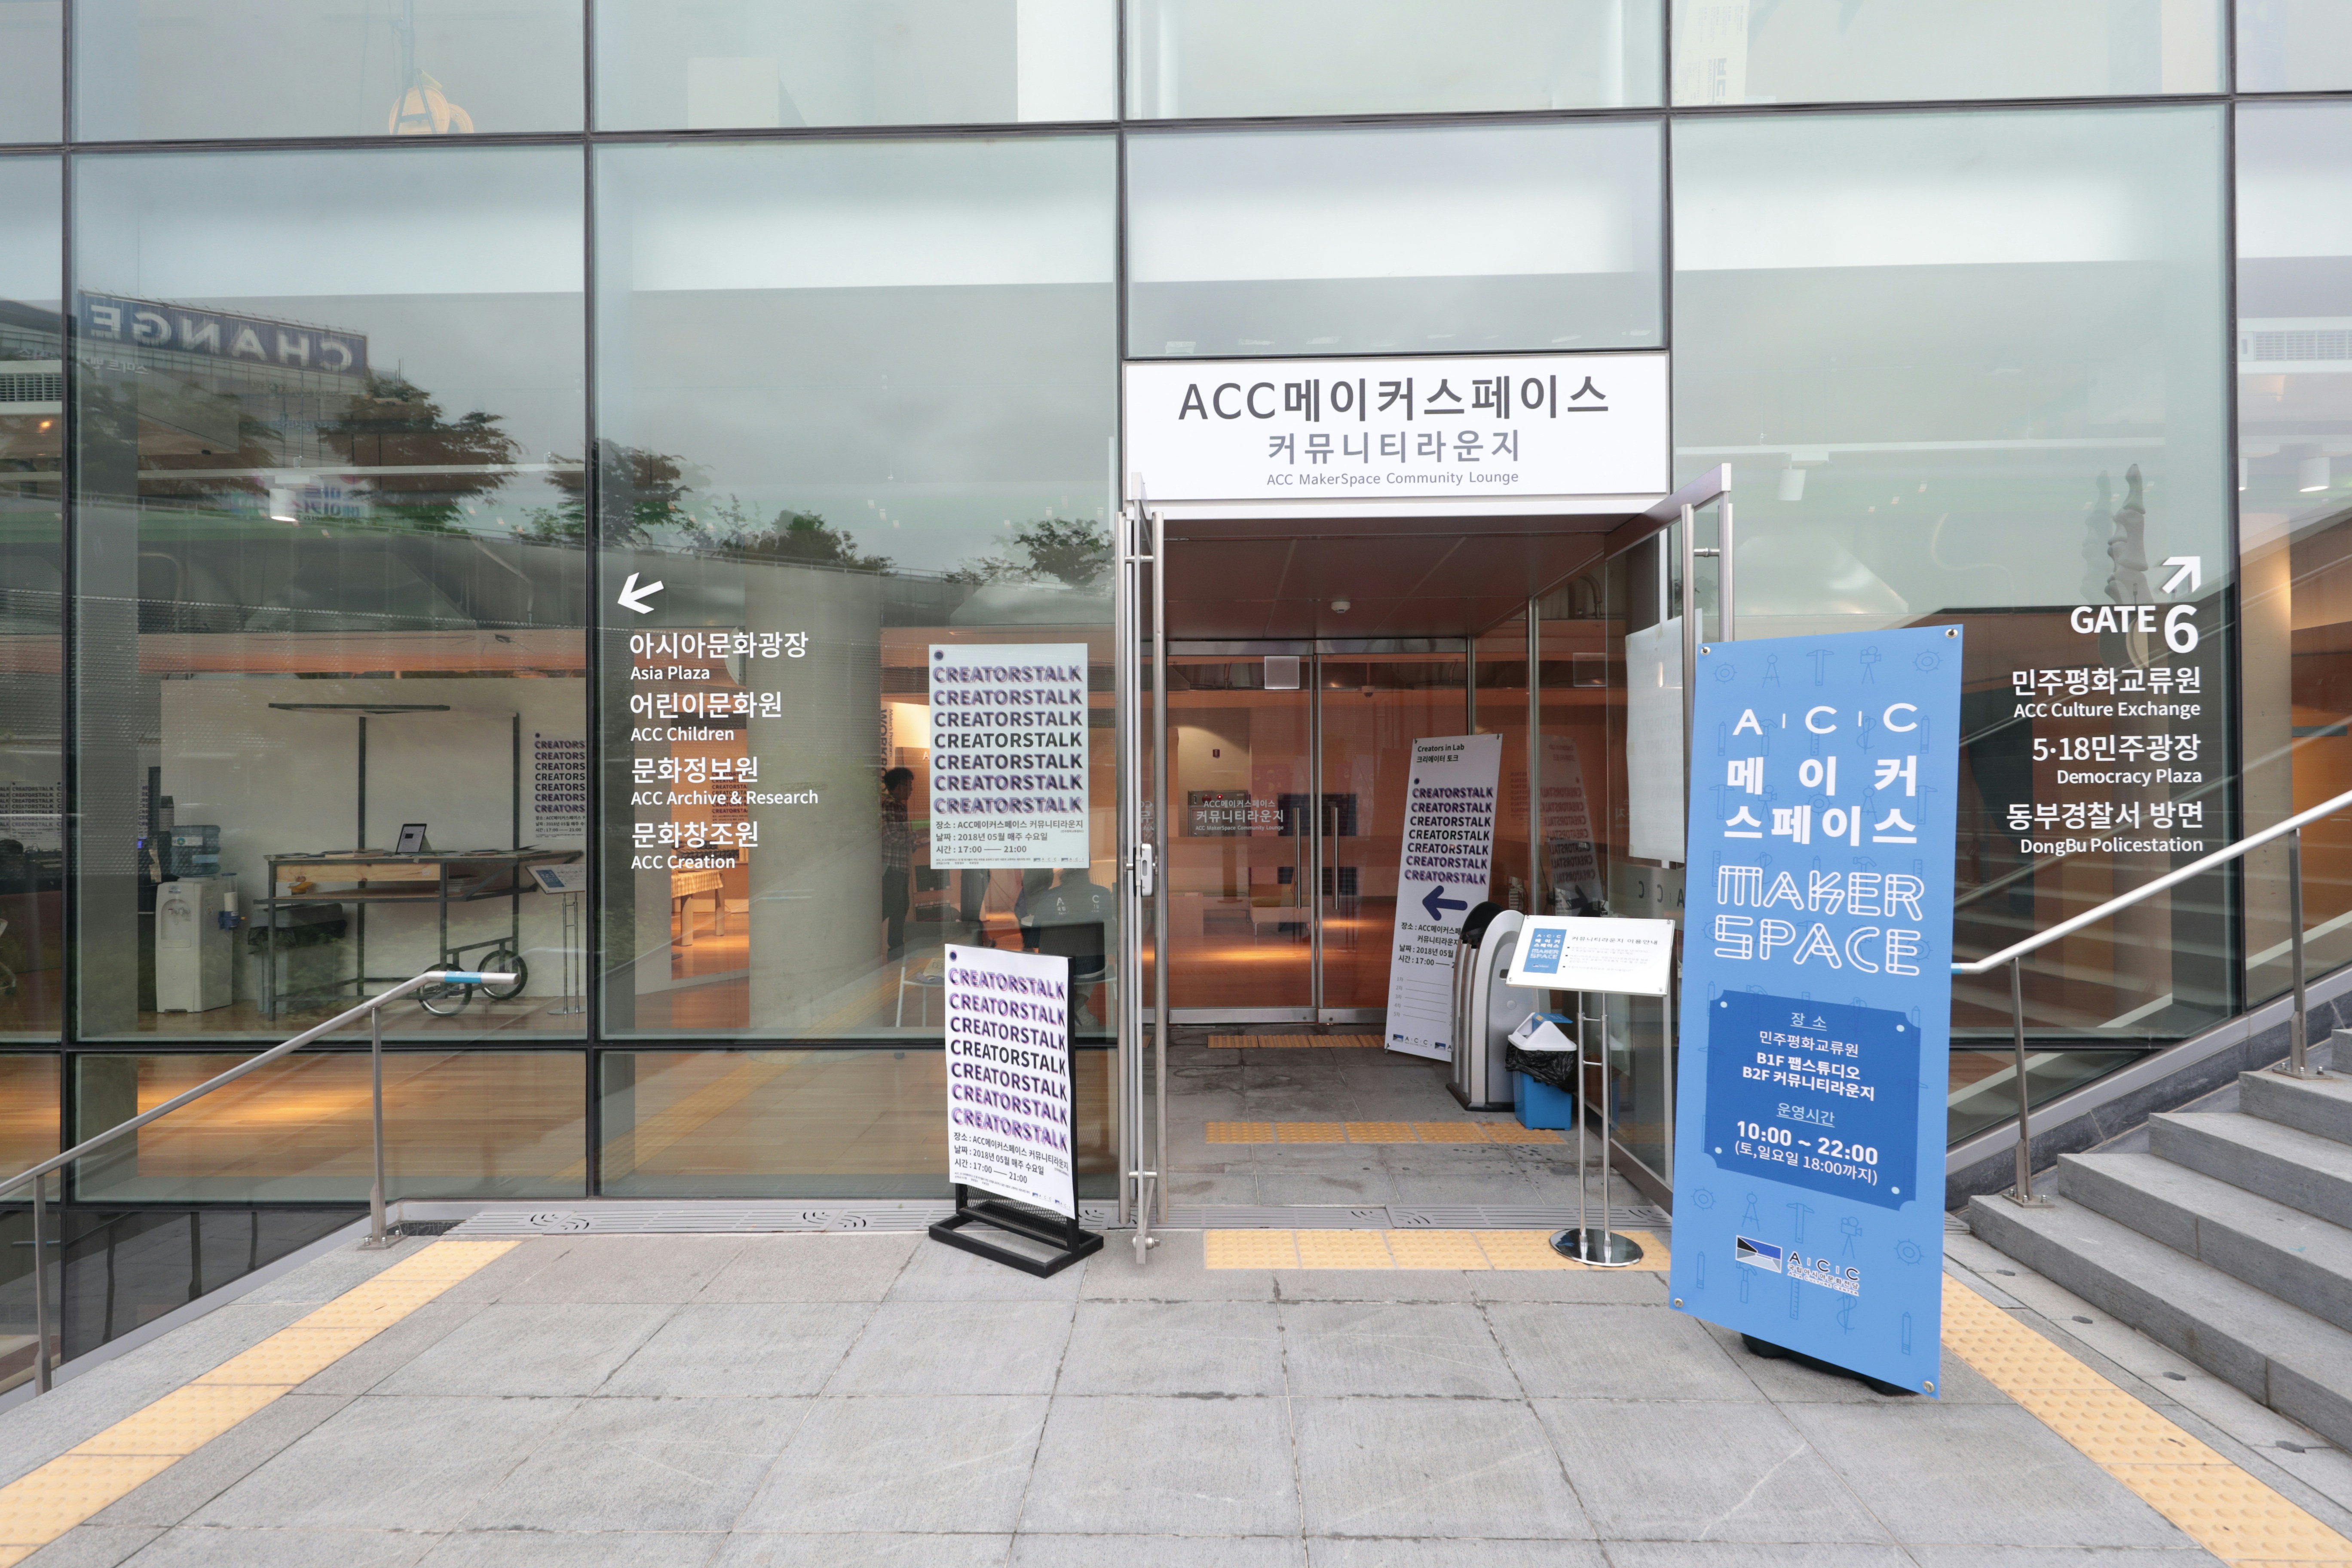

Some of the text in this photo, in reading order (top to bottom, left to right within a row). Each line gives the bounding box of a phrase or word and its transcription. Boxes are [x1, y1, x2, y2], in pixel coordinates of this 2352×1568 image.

[1179, 375, 1608, 422] ACC메이커스페이스
[1268, 430, 1519, 464] 커뮤니티라운지
[1267, 471, 1519, 487] ACC MakerSpace Community Lounge
[2070, 604, 2198, 653] GATE 6
[630, 631, 809, 659] 아시아문화광장
[631, 666, 710, 680] Asia Plaza
[933, 665, 1084, 683] CREATORSTALK
[2012, 667, 2200, 696] 민주평화교류원
[630, 692, 781, 719] 어린이문화원
[933, 688, 1084, 706] CREATORSTALK
[934, 710, 1083, 727] CREATORSTALK
[2014, 701, 2200, 720] ACC Culture Exchange
[631, 726, 734, 741] ACC Children
[934, 732, 1083, 748] CREATORSTALK
[535, 740, 585, 749] CREATORS
[2032, 734, 2201, 762] 5·18민주광장
[535, 752, 585, 760] CREATORS
[934, 753, 1083, 769] CREATORSTALK
[1417, 755, 1445, 763] 크리에이터
[632, 756, 758, 783] 문화정보원
[2057, 769, 2202, 787] Democracy Plaza
[535, 783, 585, 791] CREATORS
[934, 774, 1084, 791] CREATORSTALK
[535, 793, 585, 802] CREATORS
[631, 790, 818, 805] ACC Archive & Research
[1412, 787, 1493, 799] CREATORSTALK
[535, 804, 585, 813] CREATORS
[933, 796, 1084, 814] CREATORSTALK
[1204, 799, 1275, 808] ACC메이커스페이스
[1411, 802, 1492, 813] CREATORSTALK
[958, 820, 1027, 829] ACC메이커스페이스
[1029, 820, 1083, 829] 커뮤니티라운지
[1197, 810, 1283, 823] 커뮤니티라운지
[1410, 816, 1491, 827] CREATORSTALK
[2006, 801, 2203, 830] 동부경찰서 방면
[632, 821, 758, 848] 문화창조원
[1724, 805, 1917, 846] 스페이스
[936, 832, 1048, 842] 날짜 2018년 05월 매주 수요일
[1409, 830, 1490, 841] CREATORSTALK
[936, 845, 1027, 854] 시간 17:00 21:00
[1407, 843, 1488, 855] CREATORSTALK
[2021, 837, 2203, 856] DongBu Policestation
[631, 854, 735, 869] ACC Creation
[1406, 855, 1488, 869] CREATORSTALK
[1405, 869, 1486, 885] CREATORSTALK
[1717, 865, 1924, 921] MAKER
[1418, 925, 1461, 935] ACC메이커스페
[1416, 947, 1438, 956] 2018년
[1439, 949, 1453, 958] 05월
[1715, 914, 1921, 976] SPACE
[948, 967, 1066, 1002] CREATORSTALK
[949, 992, 1066, 1028] CREATORSTALK
[950, 1016, 1066, 1053] CREATORSTALK
[1760, 1031, 1859, 1058] 민주평화교류원
[950, 1039, 1066, 1076] CREATORSTALK
[1757, 1052, 1861, 1080] B1F 팹스튜디오
[951, 1062, 1067, 1102] CREATORSTALK
[1743, 1066, 1874, 1101] B2F 커뮤니티라운지
[951, 1083, 1068, 1127] CREATORSTALK
[1777, 1103, 1834, 1126] 운영시간
[951, 1107, 1068, 1154] CREATORSTALK
[954, 1132, 1069, 1172] 장소 ACC메이커스페이스 커뮤니티라운지
[1737, 1121, 1792, 1146] 10:00
[1818, 1137, 1878, 1165] 22:00
[954, 1145, 968, 1155] 날짜
[973, 1149, 995, 1162] 2018년
[996, 1155, 1010, 1166] 05월
[1011, 1159, 1024, 1170] 매주
[1026, 1162, 1044, 1176] 수요일
[1735, 1140, 1877, 1186] (토,일요일 18:00까지)
[954, 1158, 968, 1169] 시간
[973, 1162, 992, 1174] 17:00
[1009, 1172, 1027, 1183] 21:00
[1788, 1264, 1859, 1290] 국립아시아문화전당
